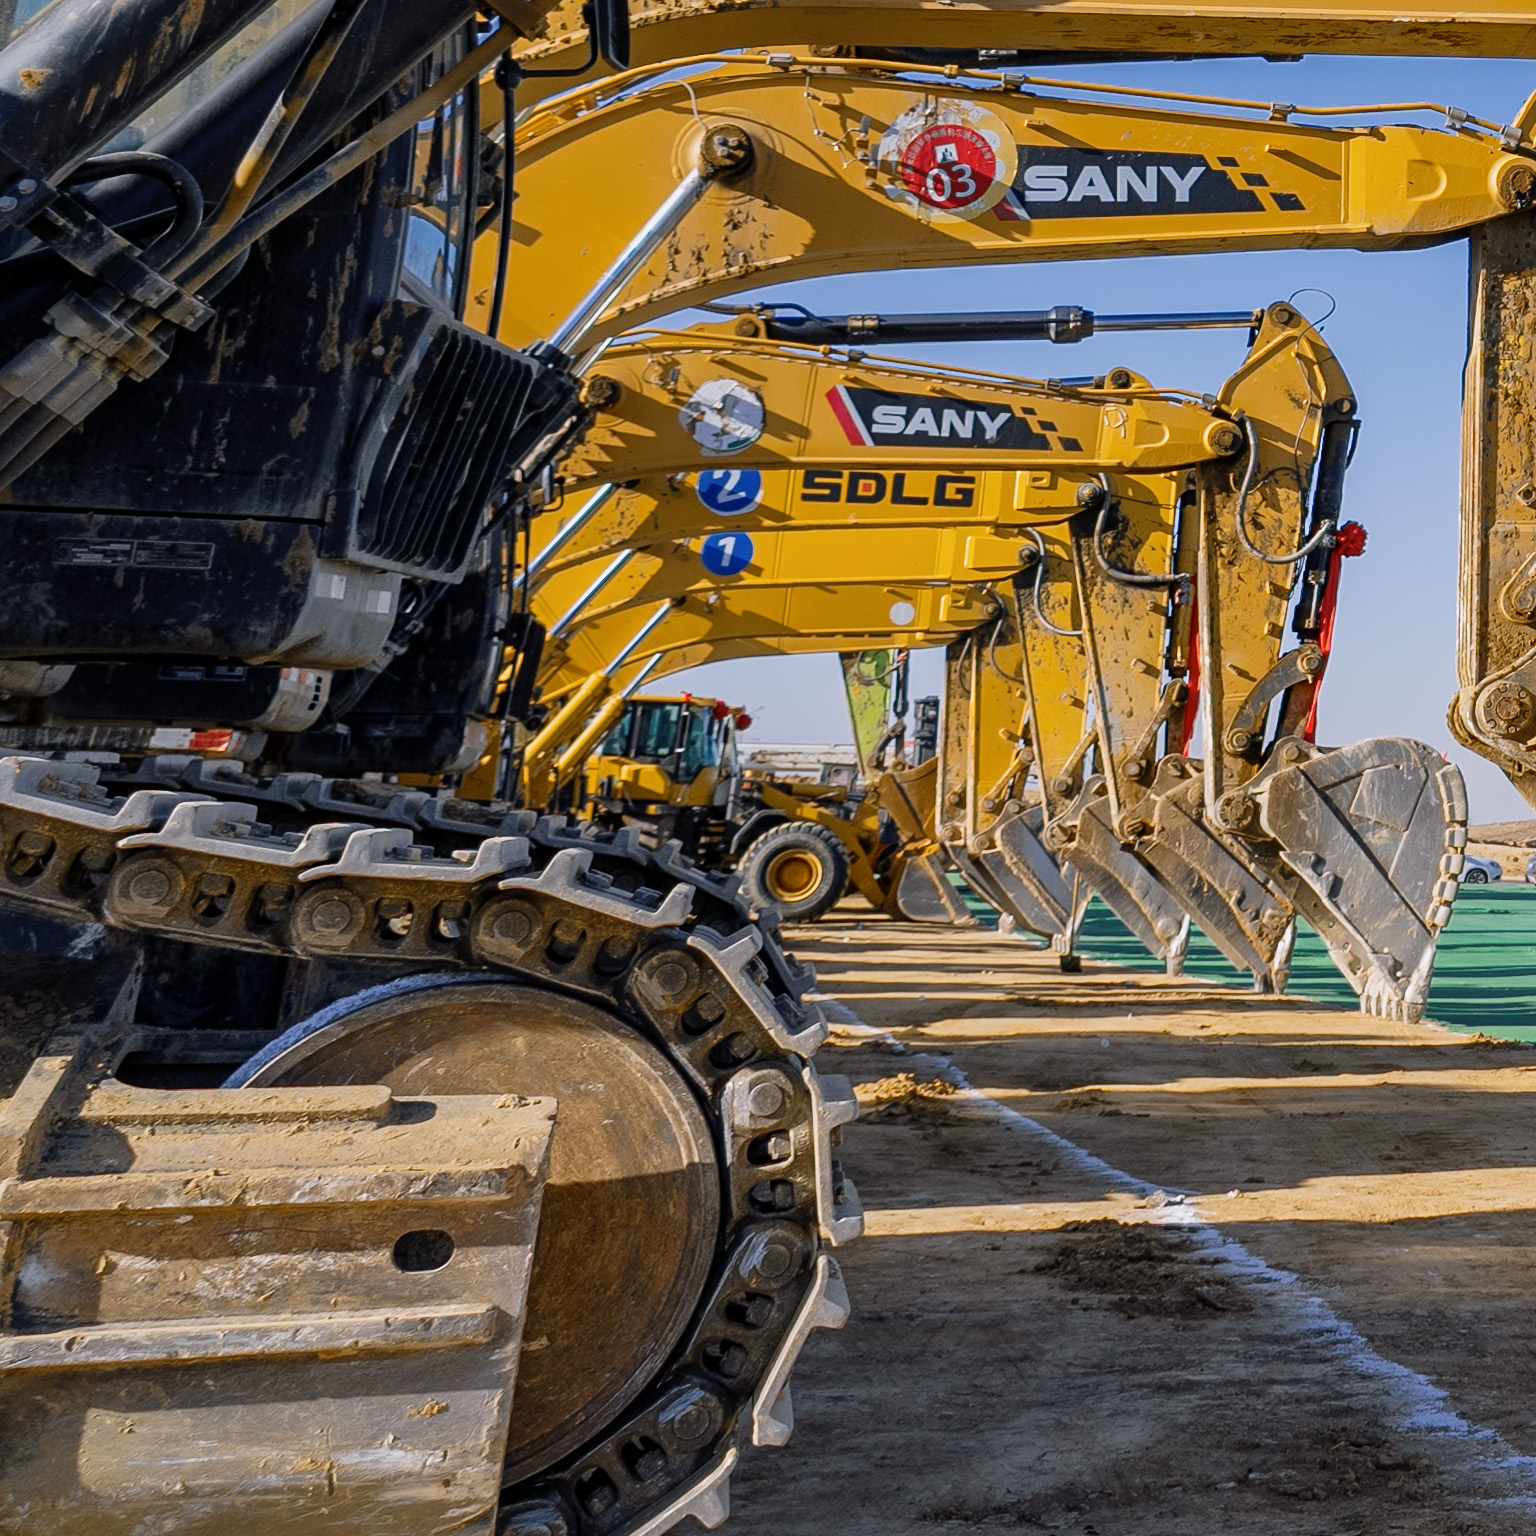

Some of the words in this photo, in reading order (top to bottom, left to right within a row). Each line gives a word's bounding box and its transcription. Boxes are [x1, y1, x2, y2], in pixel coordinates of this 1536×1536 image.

[926, 164, 977, 202] 03
[1023, 164, 1207, 203] SANY
[871, 404, 1012, 440] SANY
[713, 469, 746, 504] 2
[801, 470, 977, 508] SDLG
[718, 536, 737, 567] 1
